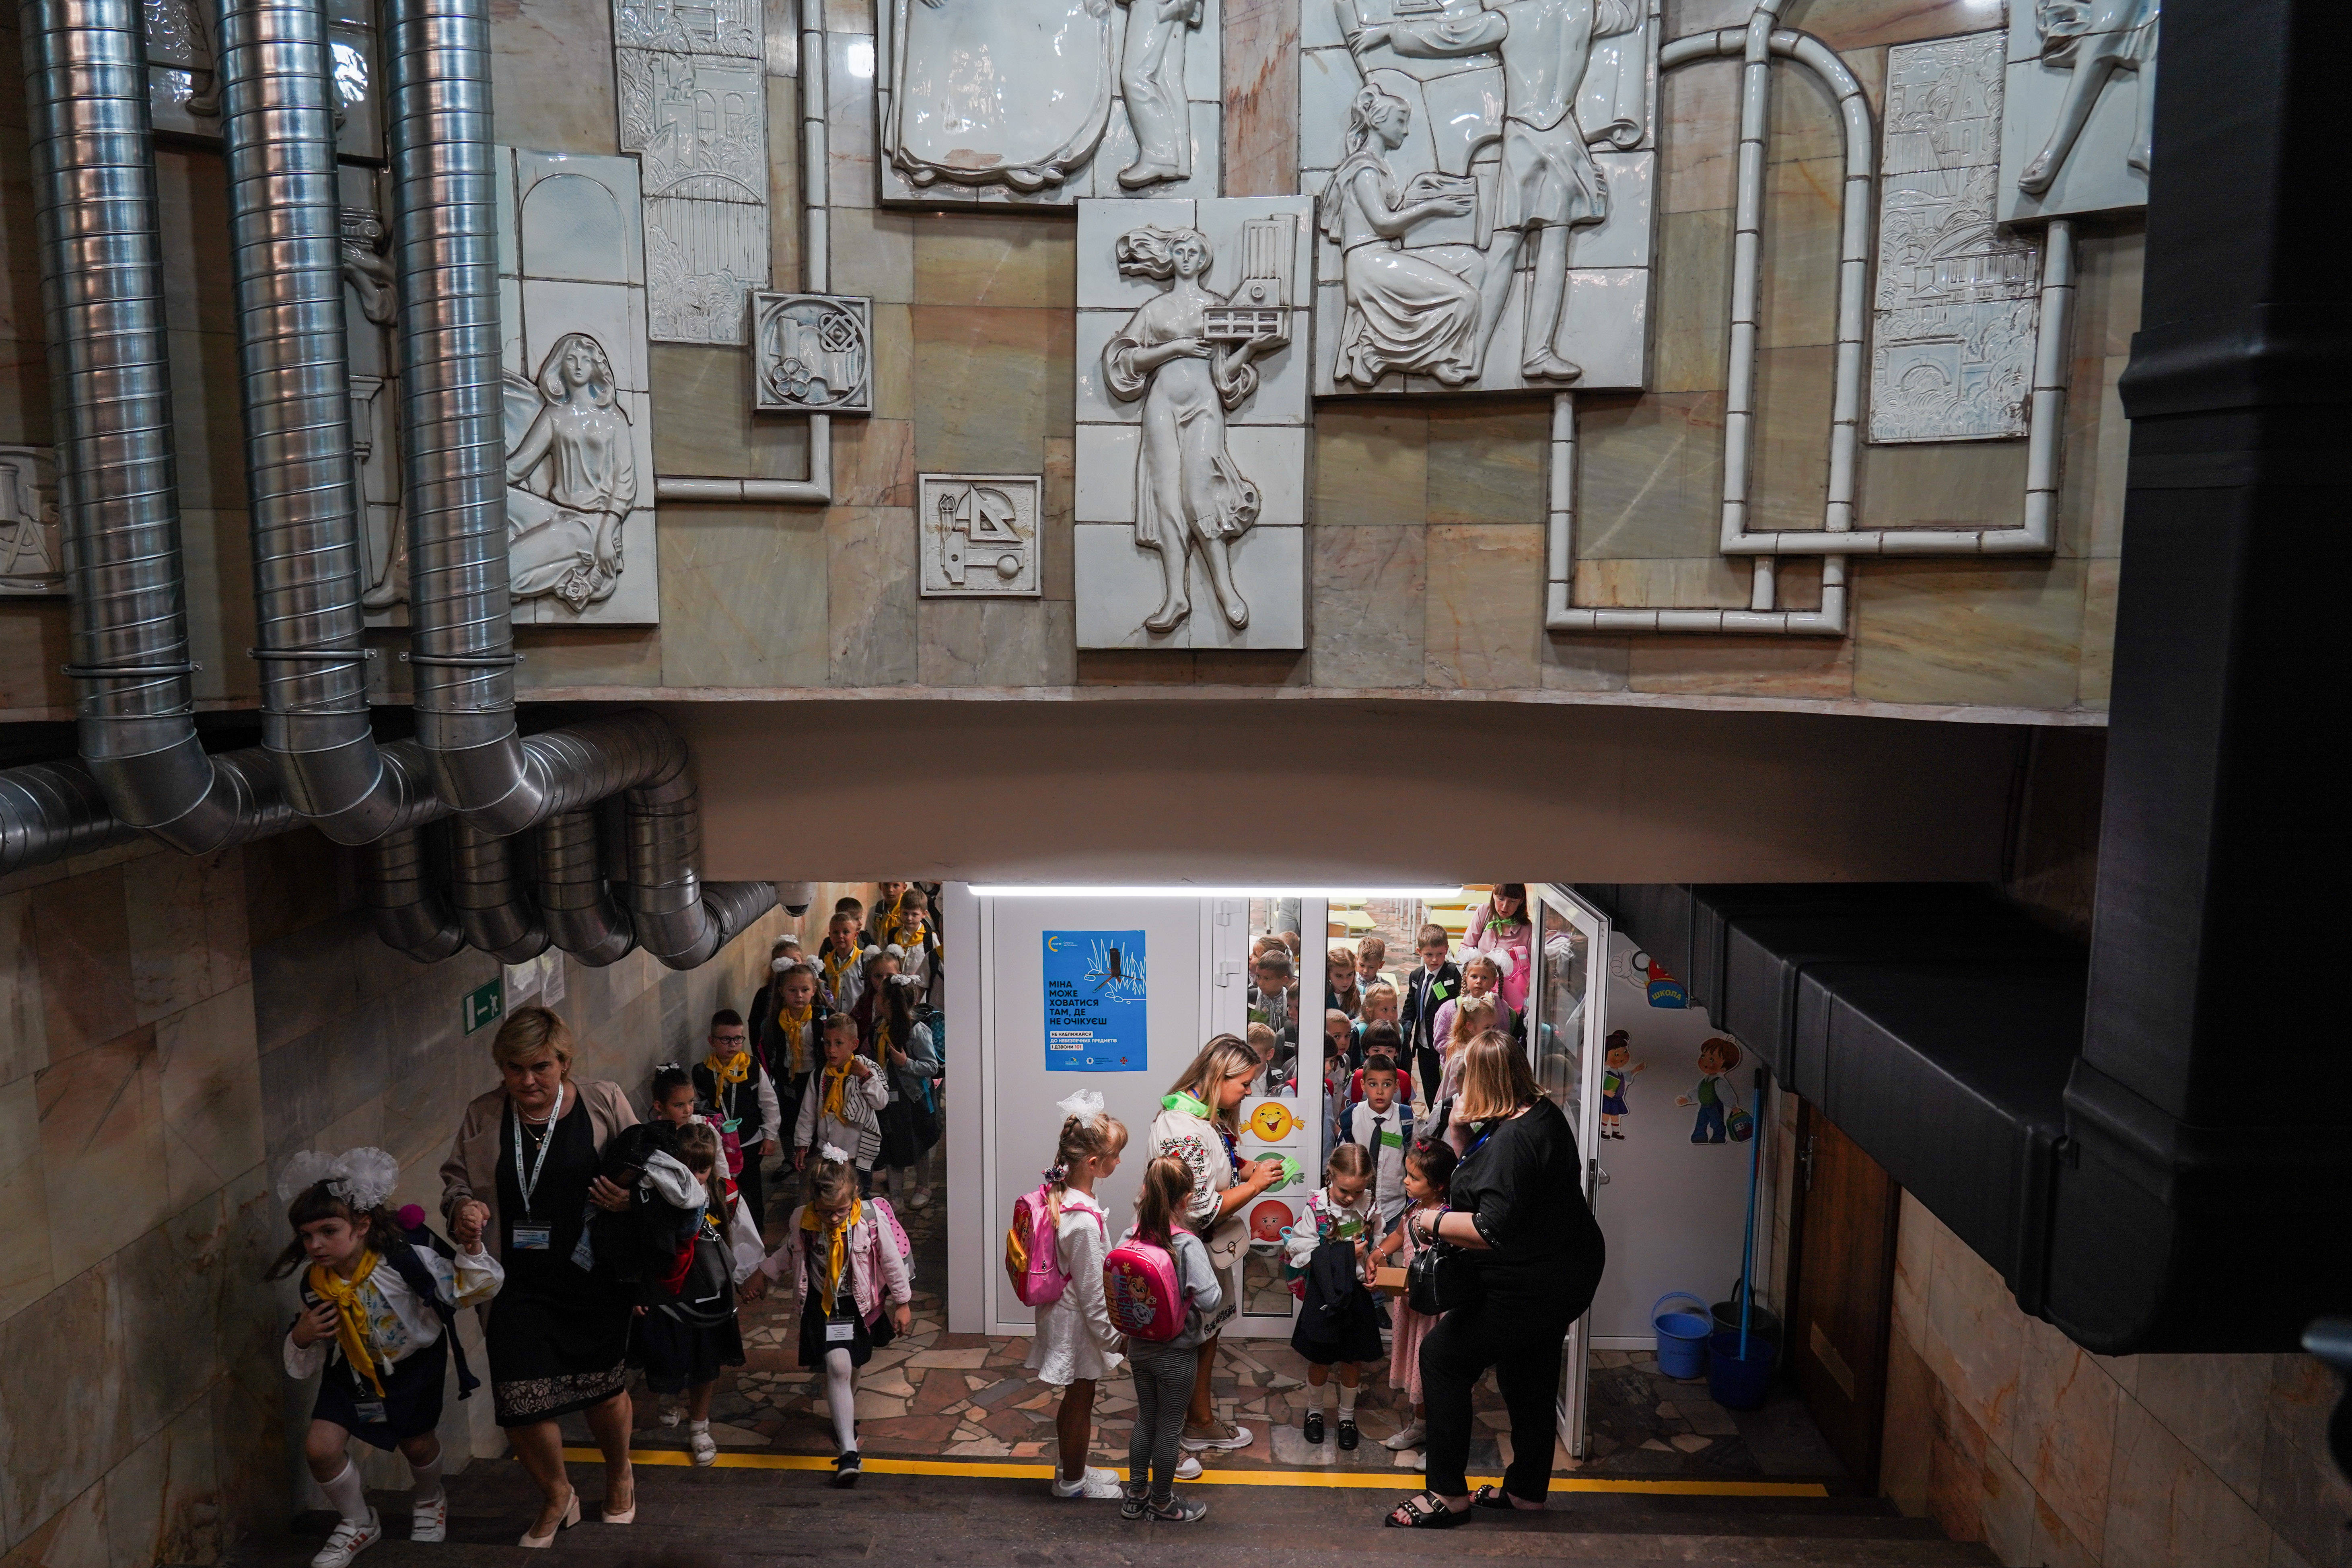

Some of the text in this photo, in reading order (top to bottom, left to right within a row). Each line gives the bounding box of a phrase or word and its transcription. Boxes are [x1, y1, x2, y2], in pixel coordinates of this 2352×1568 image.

[1652, 990, 1681, 1000] ШКОЛА
[1049, 1008, 1086, 1017] ТАМ, ДЕ
